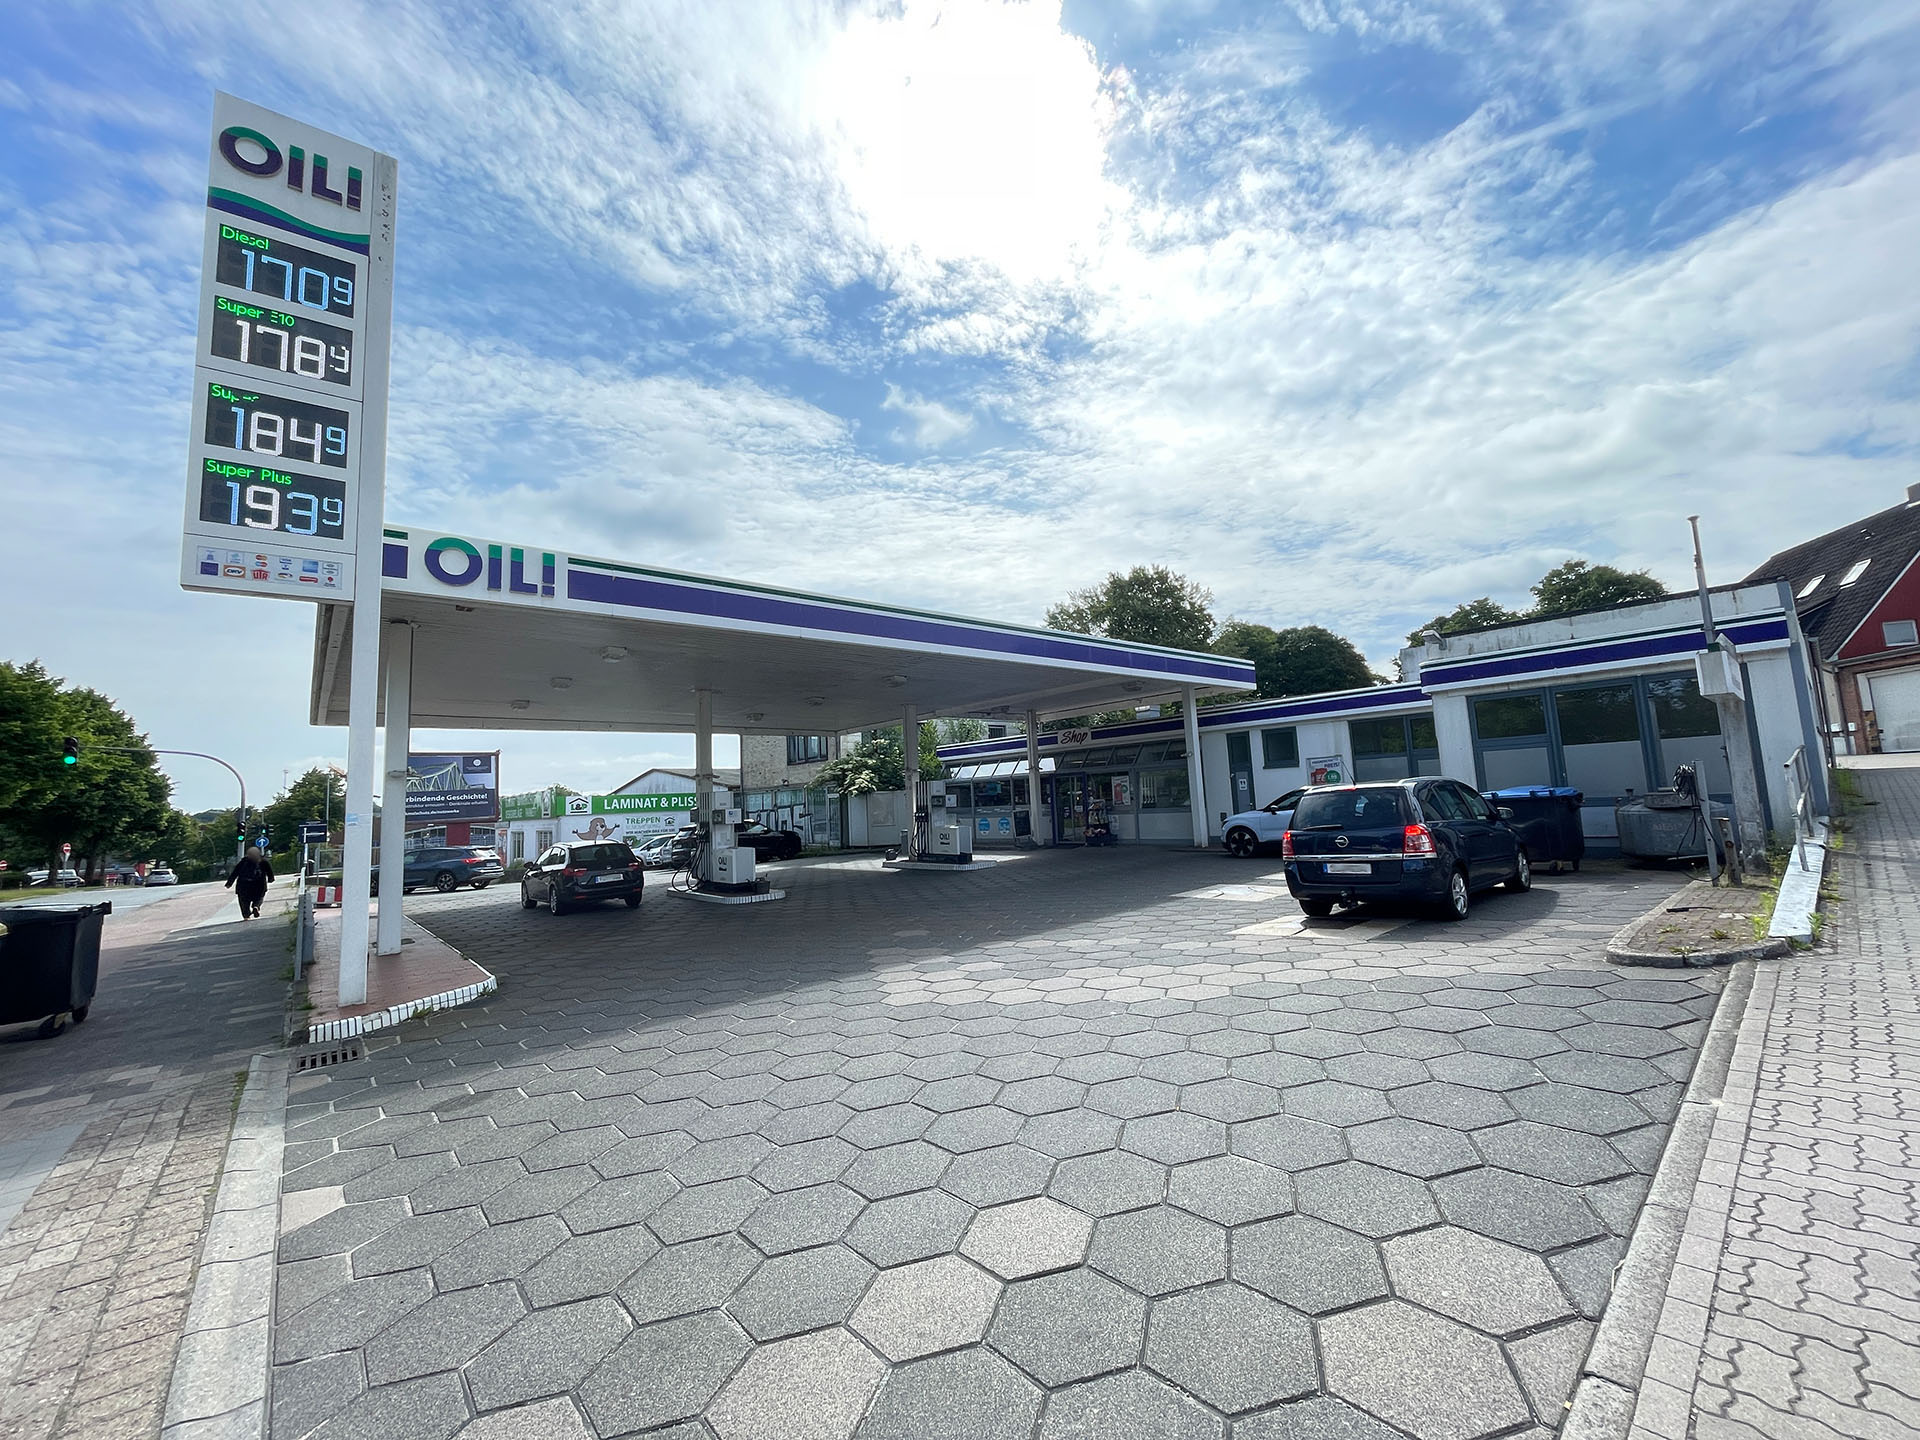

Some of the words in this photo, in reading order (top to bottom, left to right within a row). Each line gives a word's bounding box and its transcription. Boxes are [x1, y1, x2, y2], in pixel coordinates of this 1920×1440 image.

[219, 126, 362, 212] OIL!
[222, 225, 269, 250] Diesel
[217, 297, 265, 319] Super
[270, 311, 295, 328] E10
[206, 459, 255, 479] Super
[261, 469, 292, 486] Plus
[424, 537, 556, 598] OIL!
[1061, 730, 1089, 745] Shop
[405, 794, 445, 803] rbindende
[446, 793, 488, 801] Geschichte!
[571, 803, 588, 811] L&P
[604, 798, 658, 810] LAMINAT
[660, 797, 669, 808] &
[671, 796, 697, 807] PLIS
